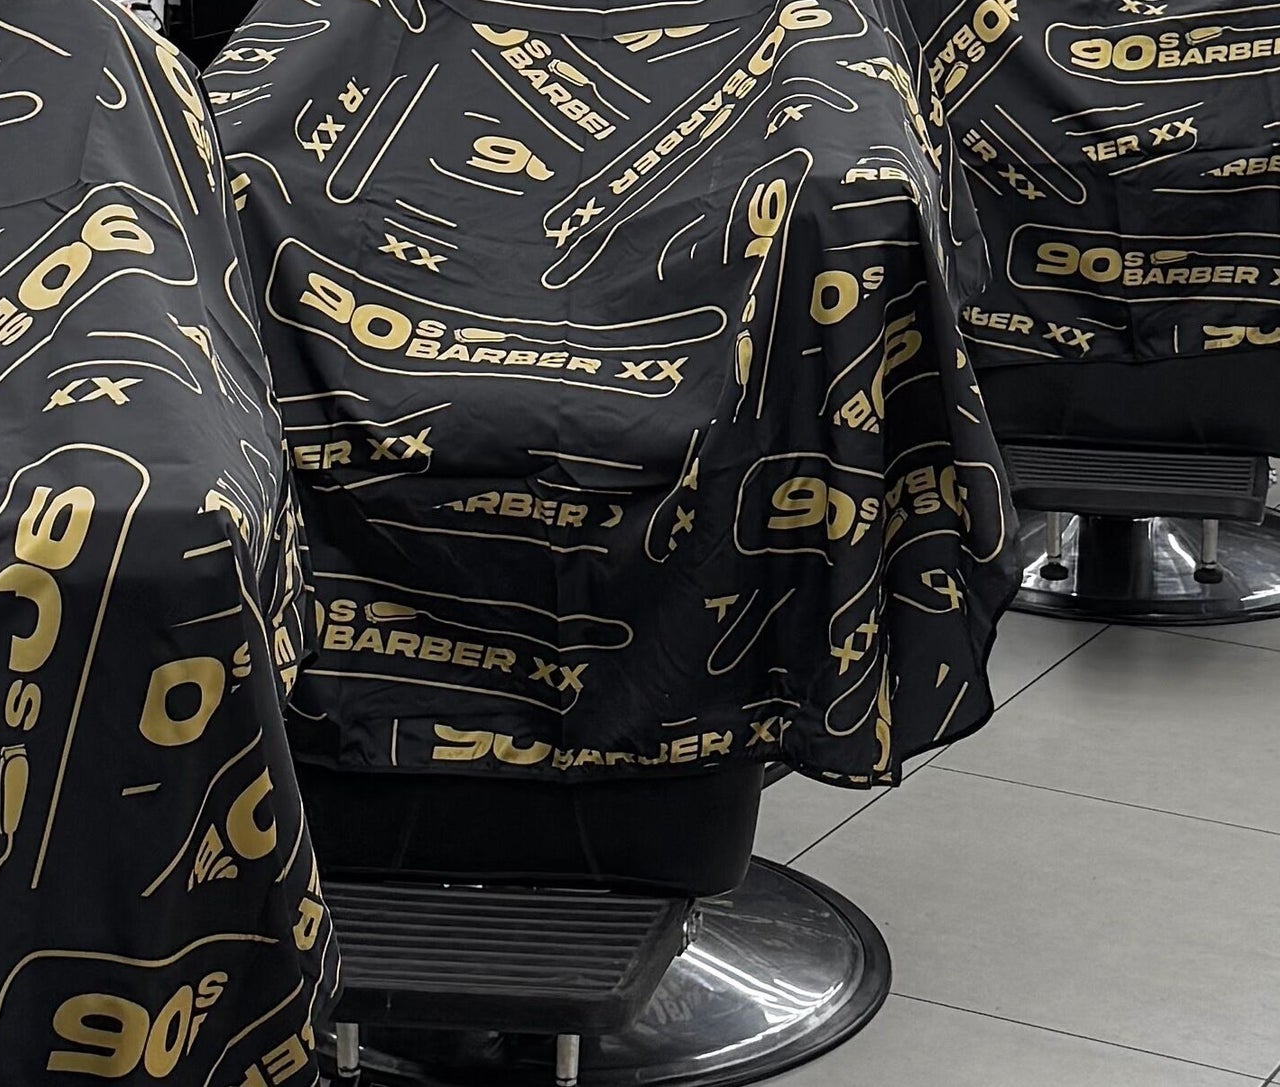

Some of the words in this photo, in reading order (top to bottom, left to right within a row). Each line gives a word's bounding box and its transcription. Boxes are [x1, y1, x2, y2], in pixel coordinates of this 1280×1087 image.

[608, 68, 756, 199] BARBER
[1148, 117, 1197, 144] XX
[998, 164, 1046, 200] XX
[548, 197, 606, 250] XX
[377, 233, 448, 273] XX
[1122, 266, 1258, 287] BARBER
[404, 335, 601, 378] BARBER
[612, 356, 690, 384] XX
[369, 427, 433, 462] XX
[324, 625, 517, 674] BARBER
[529, 656, 590, 694] XX
